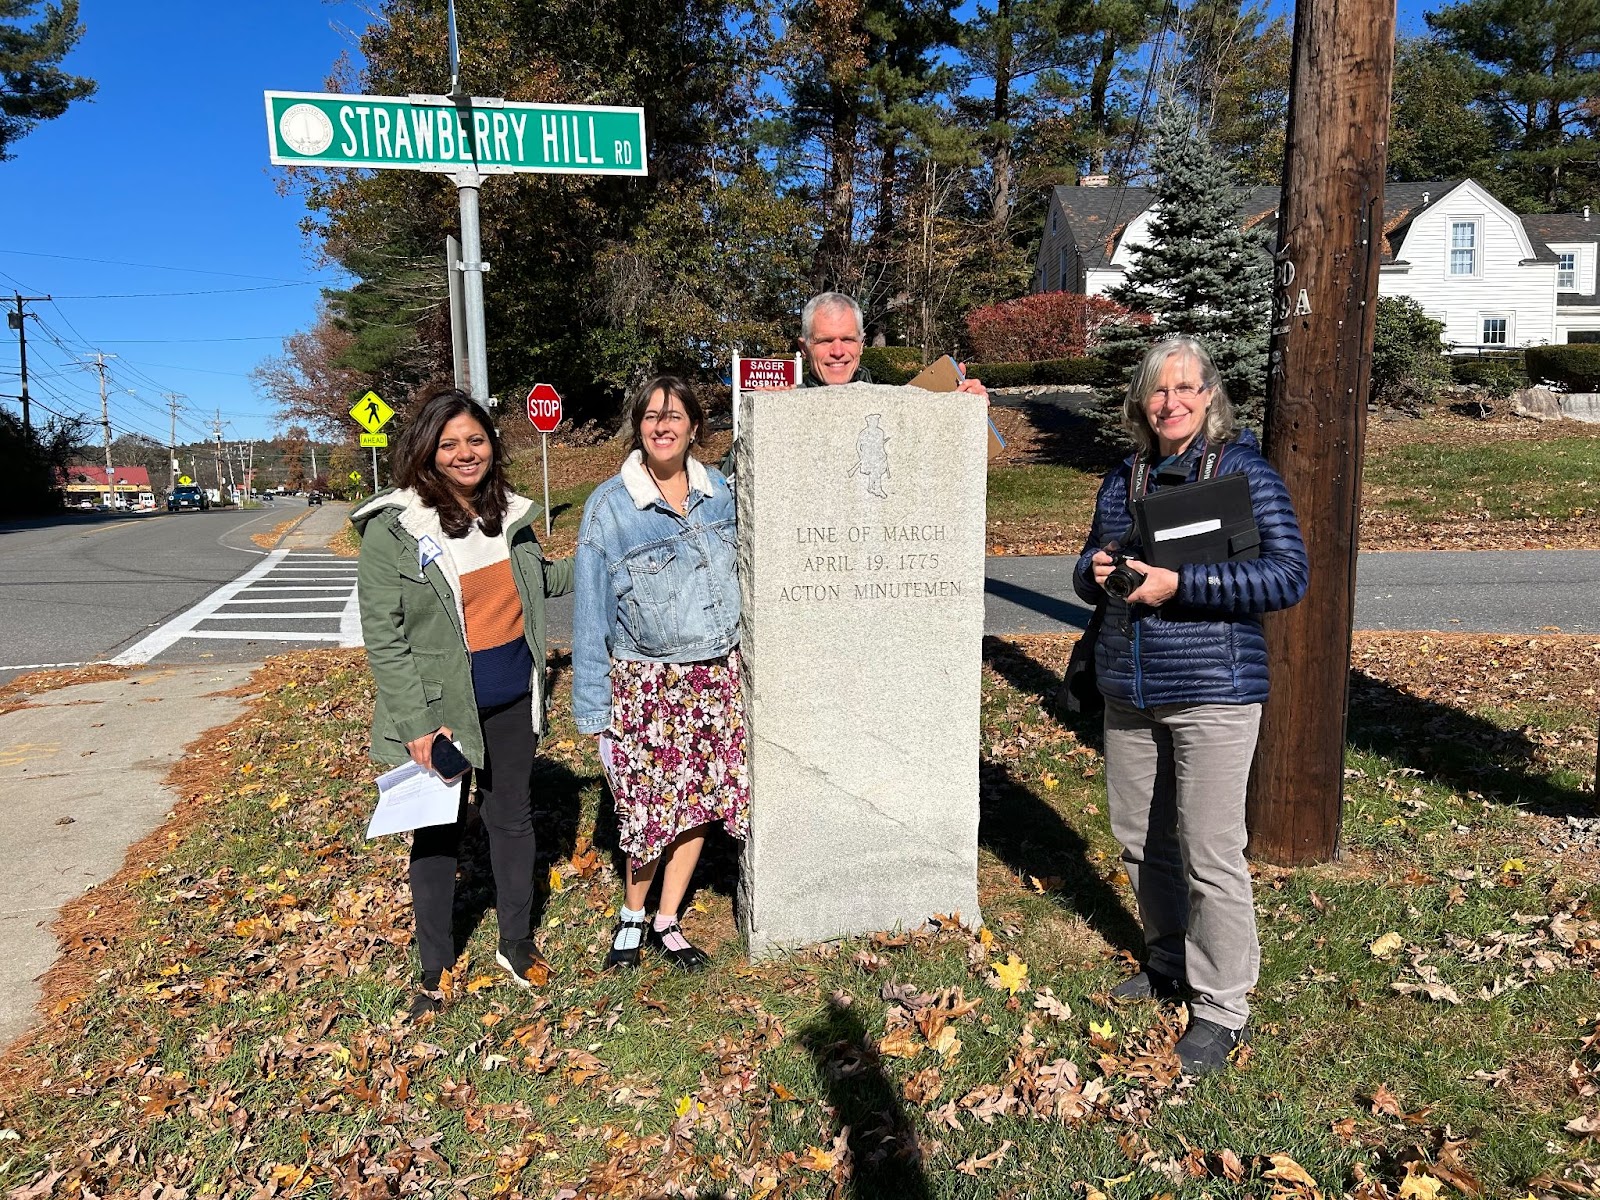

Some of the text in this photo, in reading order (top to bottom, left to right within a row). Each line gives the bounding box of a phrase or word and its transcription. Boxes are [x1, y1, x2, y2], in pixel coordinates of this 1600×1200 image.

[339, 106, 528, 162] STRAWBERRY
[542, 114, 604, 164] HILL
[615, 141, 632, 165] RD
[750, 361, 785, 371] SAGER
[749, 371, 786, 380] ANIMAL
[530, 399, 560, 417] STOP
[363, 436, 385, 444] AHEAD
[1203, 453, 1217, 480] Canon
[1135, 463, 1146, 493] DIGITAL
[796, 525, 946, 543] LINE OF MARCH
[803, 555, 854, 572] APRIL
[899, 554, 940, 570] 1775
[778, 581, 962, 602] ACTON MINUTEMEN
